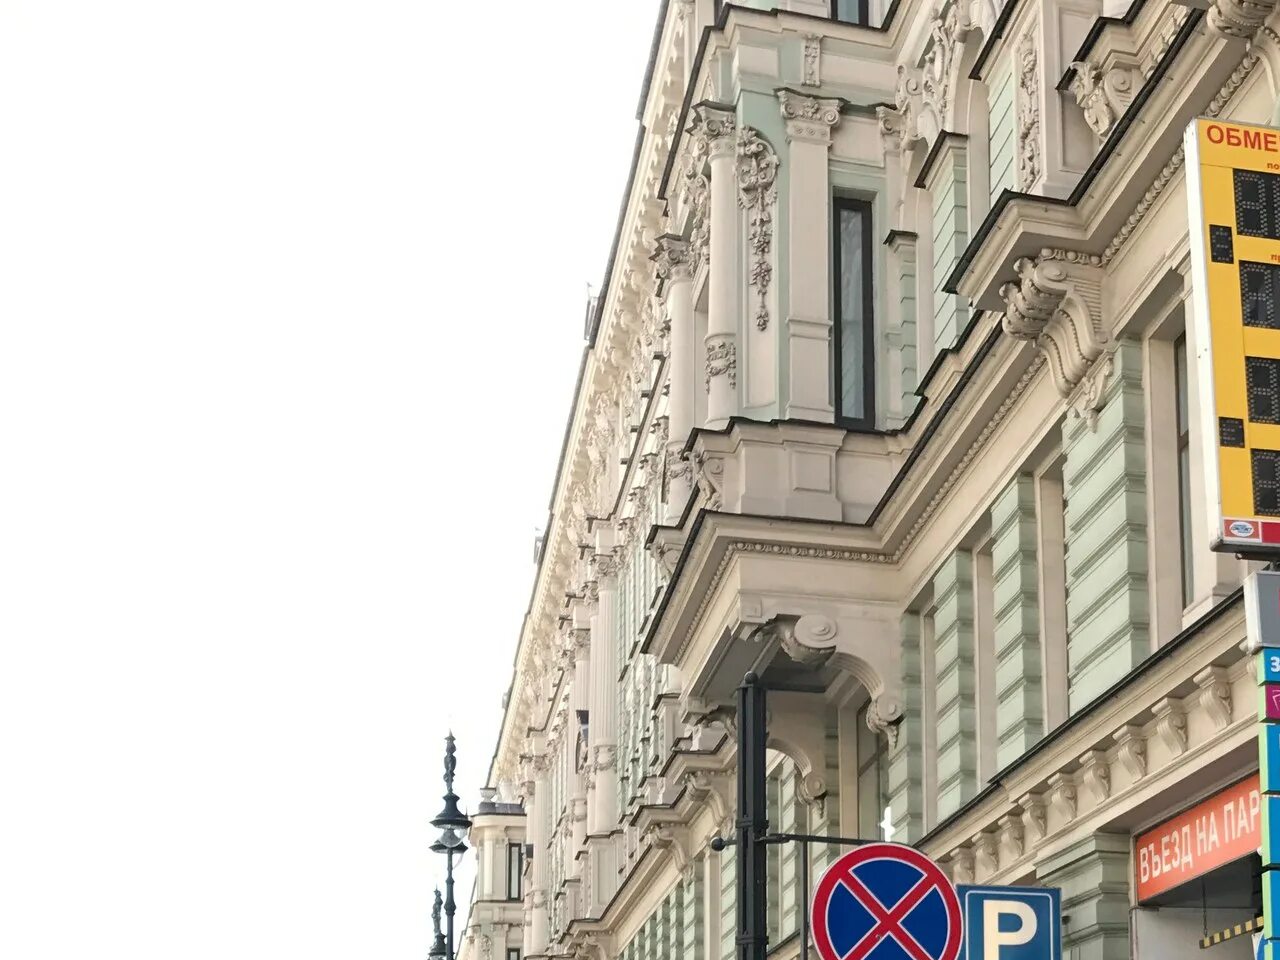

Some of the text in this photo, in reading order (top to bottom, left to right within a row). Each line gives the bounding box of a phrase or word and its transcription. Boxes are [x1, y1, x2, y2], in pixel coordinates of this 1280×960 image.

[1140, 789, 1260, 883] ВЪЕЗД НА ПАР
